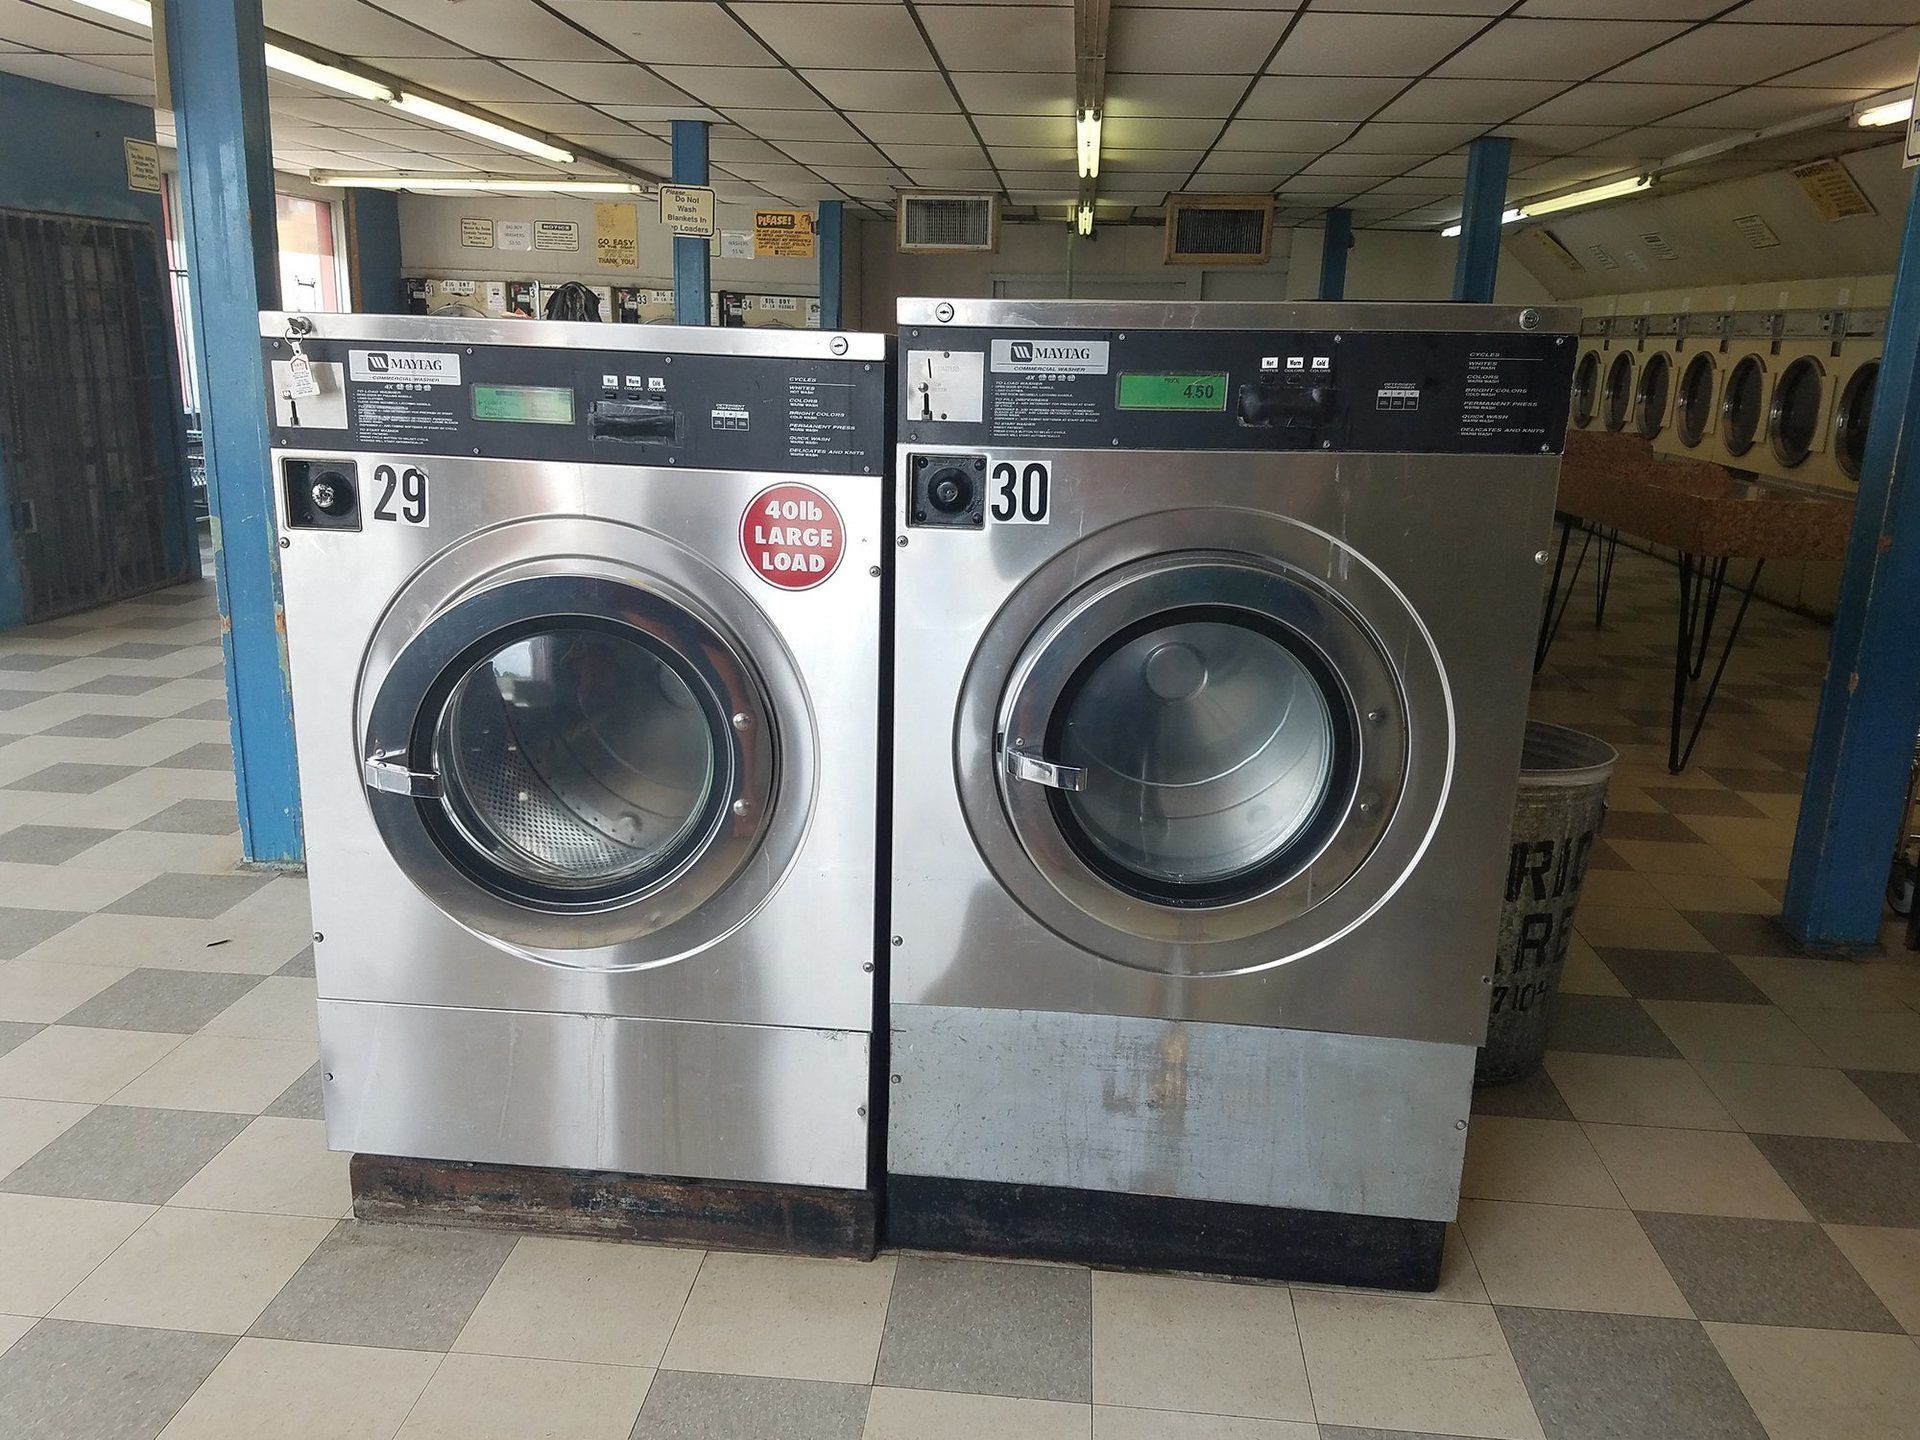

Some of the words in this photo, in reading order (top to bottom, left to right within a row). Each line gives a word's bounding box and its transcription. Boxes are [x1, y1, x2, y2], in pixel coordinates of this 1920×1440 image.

[677, 205, 697, 213] Wash
[667, 214, 698, 223] Blankets
[758, 214, 792, 226] PLEASE!
[680, 225, 708, 233] Loaders
[612, 238, 635, 246] EASY
[425, 284, 434, 297] 31
[637, 294, 647, 305] 33
[742, 299, 752, 311] 34
[1035, 347, 1090, 360] MAYTAG
[391, 358, 442, 371] MAYTAG
[1183, 384, 1214, 399] 4.50
[374, 464, 426, 524] 29
[991, 462, 1049, 522] 30
[764, 500, 823, 521] 40lb
[755, 525, 833, 548] LARGE
[762, 551, 826, 572] LOAD
